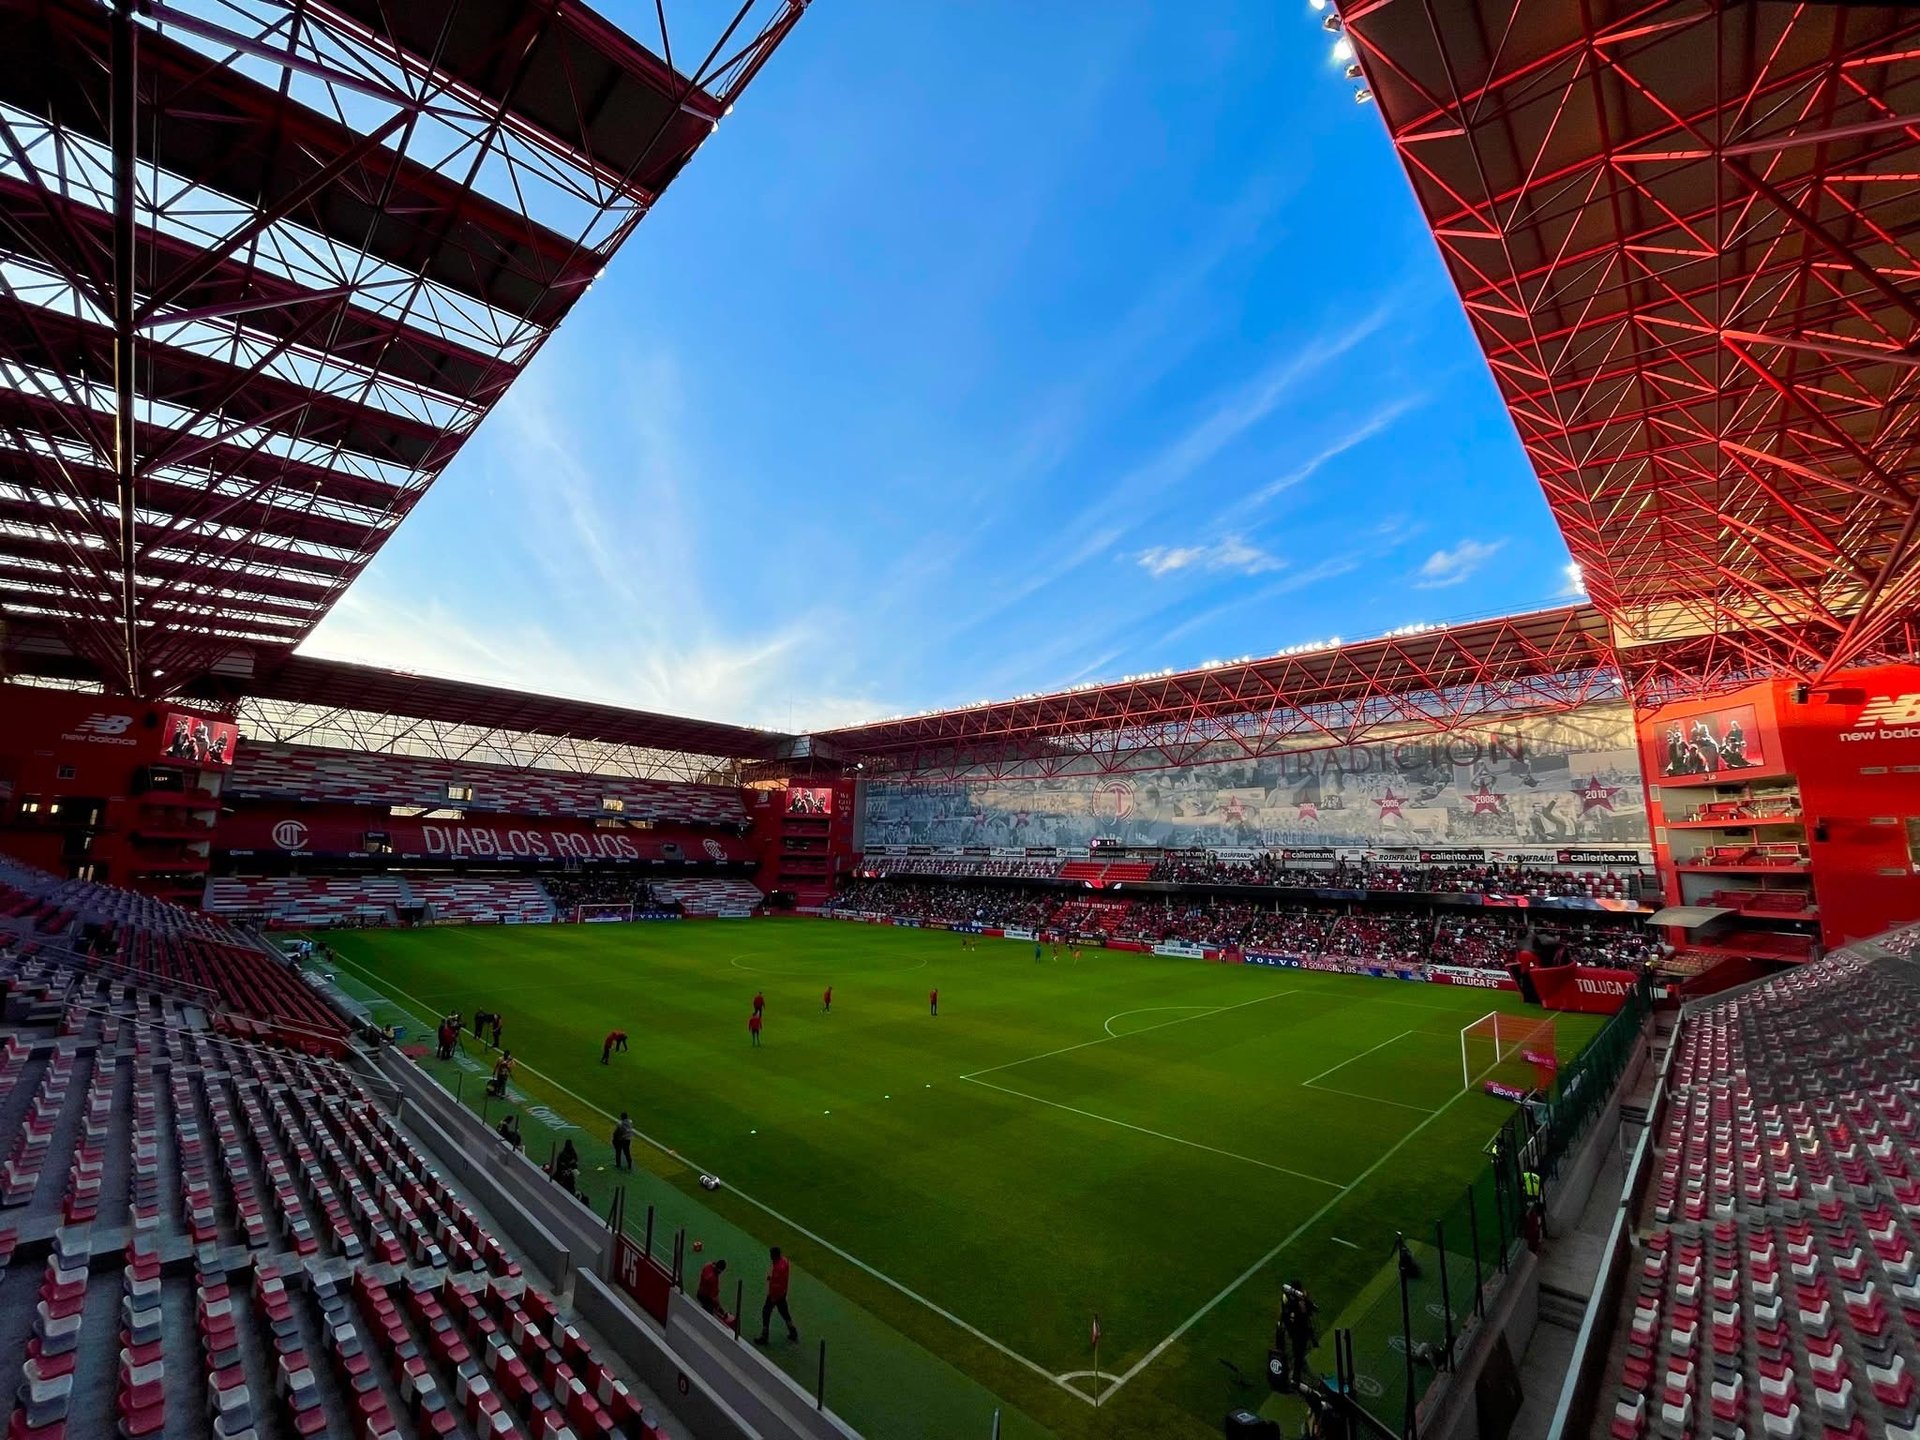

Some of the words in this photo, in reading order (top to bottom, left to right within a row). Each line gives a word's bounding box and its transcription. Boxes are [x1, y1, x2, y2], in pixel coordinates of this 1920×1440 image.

[61, 733, 87, 742] new
[88, 735, 137, 746] balance
[1840, 732, 1876, 741] new
[1475, 795, 1497, 804] 2008
[1585, 790, 1607, 800] 2010
[1381, 799, 1399, 808] 2005
[422, 825, 550, 857] DIABLOS
[551, 831, 639, 859] ROJOS
[1291, 850, 1335, 860] caliente.mx
[1378, 854, 1419, 862] ROSHFRANS
[1430, 852, 1485, 861] caliente.mx
[1506, 854, 1555, 863] ROHFRANS
[1570, 853, 1638, 862] caliente.mx
[1245, 955, 1299, 967] VOLVO
[1451, 975, 1486, 988] TOLUCA
[1486, 979, 1499, 989] FC
[1575, 978, 1625, 996] TOLUCA
